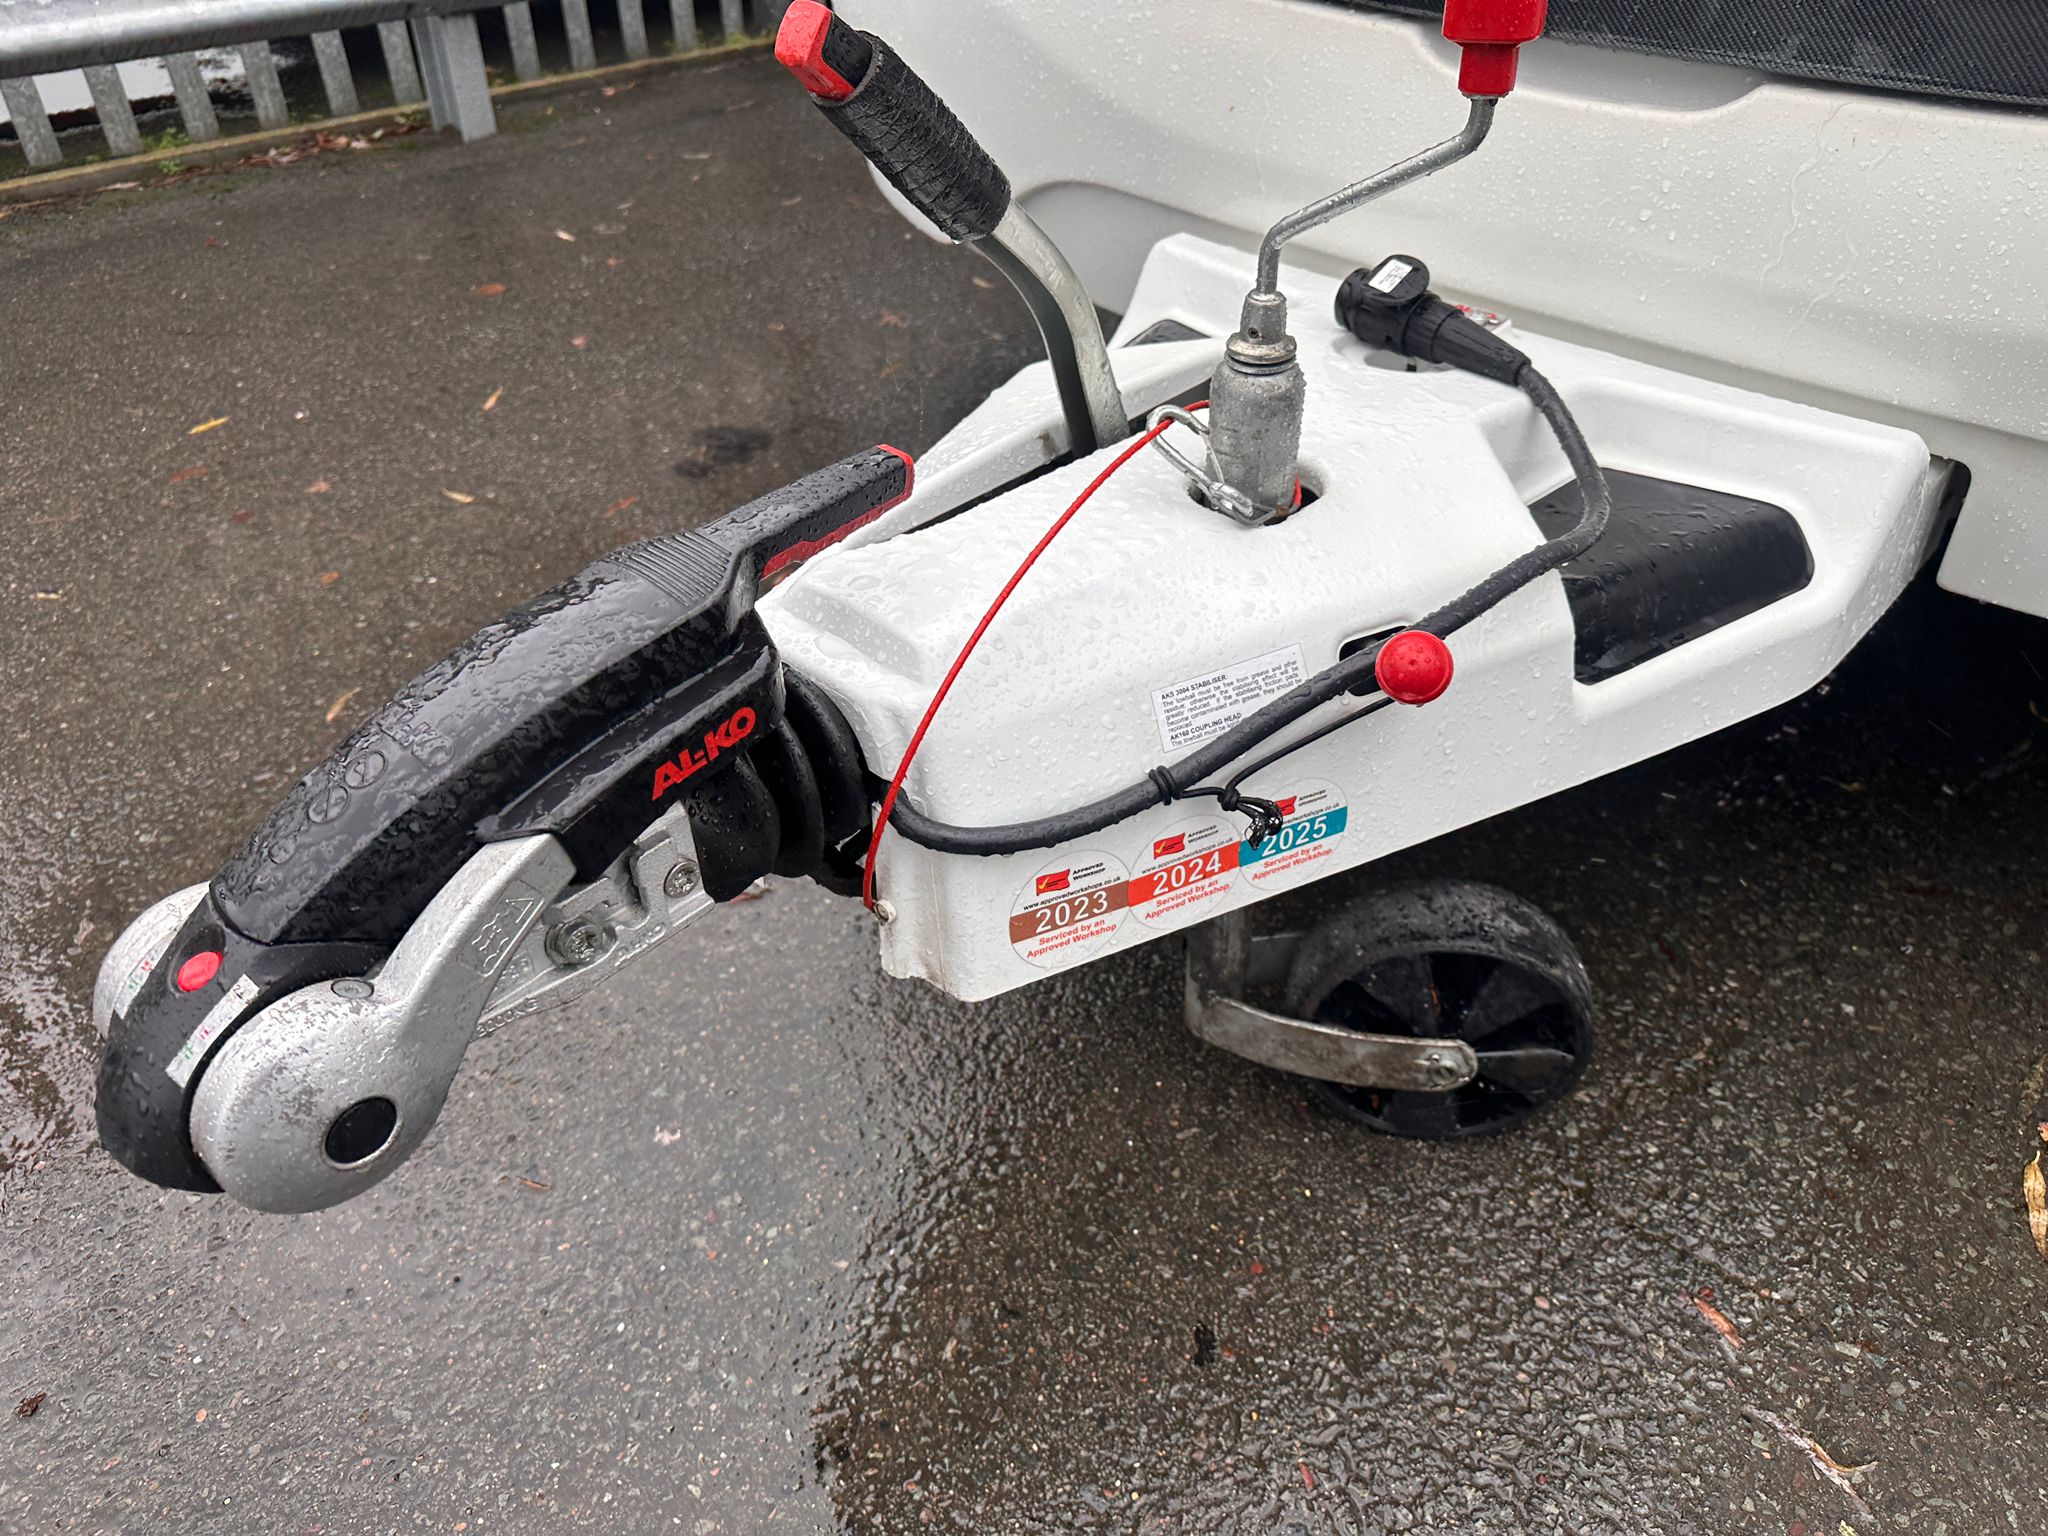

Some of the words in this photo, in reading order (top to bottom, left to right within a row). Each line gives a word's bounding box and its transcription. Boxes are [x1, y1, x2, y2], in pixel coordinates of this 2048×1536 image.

[1161, 691, 1174, 700] AKS
[1176, 686, 1189, 696] 3004
[1176, 692, 1195, 703] towball
[1198, 688, 1211, 696] must
[1251, 669, 1269, 680] grease
[1284, 660, 1297, 669] other
[1190, 694, 1216, 705] otherwise
[1262, 673, 1277, 682] effect
[1165, 710, 1184, 721] greatly
[1264, 678, 1283, 687] friction
[1167, 716, 1189, 727] become
[1191, 702, 1227, 719] contaminated
[1229, 698, 1240, 706] with
[1263, 688, 1275, 696] they
[1276, 681, 1294, 691] should
[1183, 733, 1203, 743] towball
[1204, 727, 1218, 736] must
[1191, 719, 1223, 734] COUPLING
[1224, 712, 1242, 723] HEAD
[652, 707, 756, 800] AL-KO
[1262, 815, 1327, 857] 2025
[1072, 862, 1103, 875] APPROVED
[1142, 838, 1233, 874] www.approvedworkshops.co.uk
[1252, 862, 1291, 880] Approved
[1293, 849, 1332, 866] Workshop
[1264, 851, 1299, 868] Serviced
[1301, 846, 1310, 858] by
[1153, 851, 1222, 896] 2024
[1023, 876, 1121, 911] www.approvedworkshops.co.uk
[1145, 901, 1185, 920] Approved
[1188, 884, 1230, 903] Workshop
[1156, 889, 1193, 907] Serviced
[1195, 884, 1205, 896] by
[1208, 880, 1218, 888] an
[1035, 891, 1108, 933] 2023
[1027, 940, 1070, 958] Approved
[1073, 924, 1117, 943] Workshop
[1039, 927, 1078, 945] Serviced
[1081, 923, 1091, 936] by
[1094, 920, 1104, 928] an
